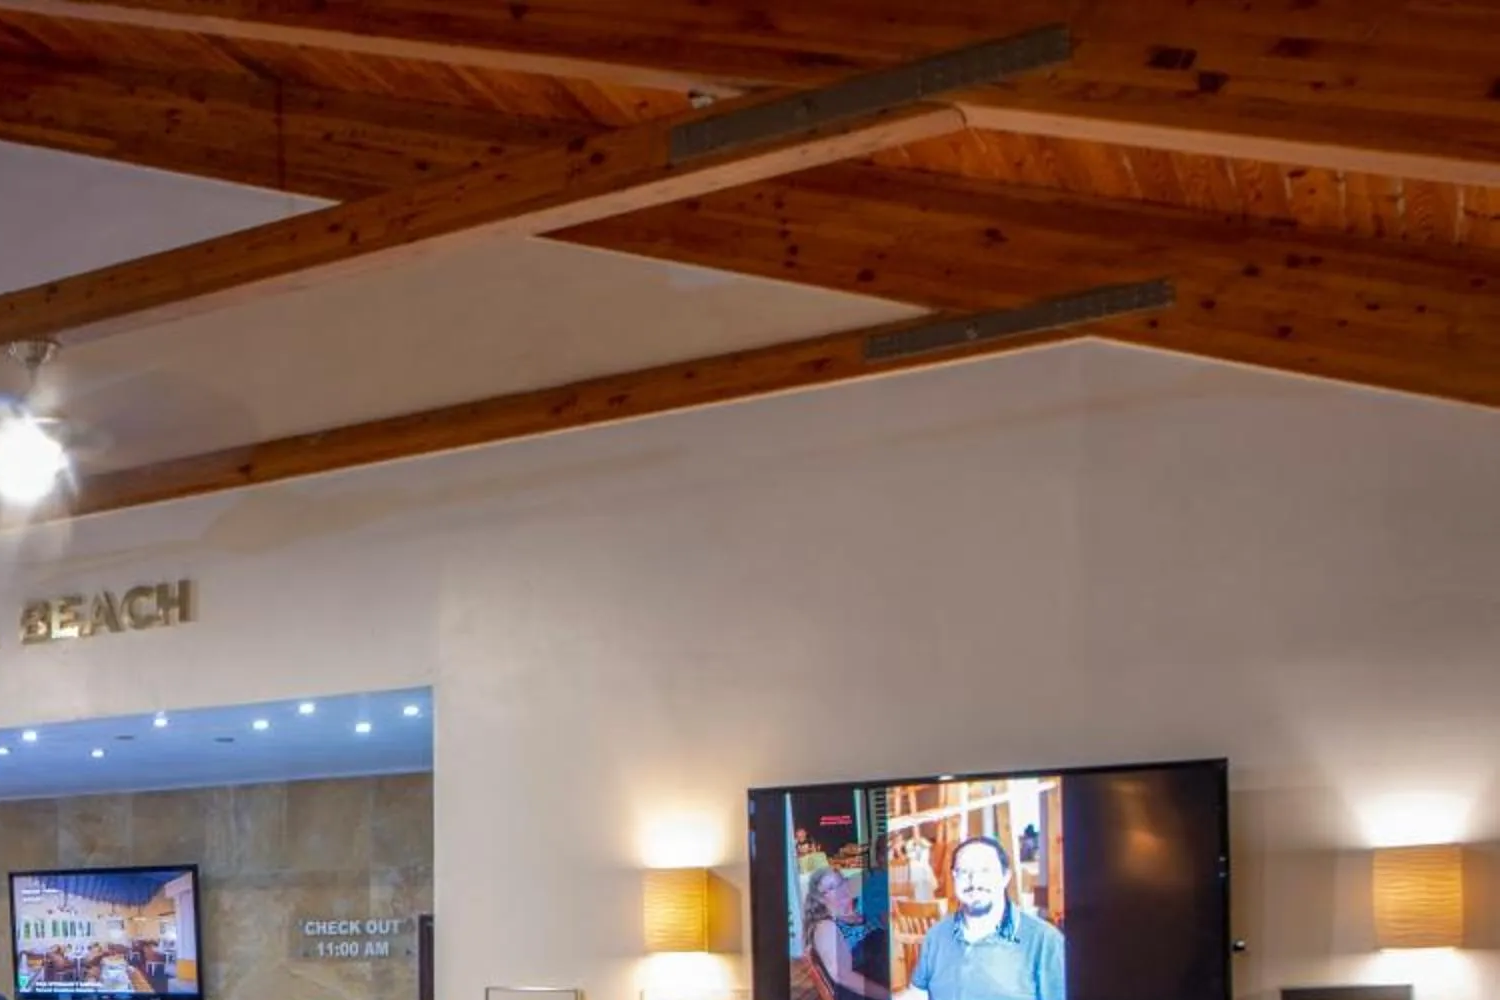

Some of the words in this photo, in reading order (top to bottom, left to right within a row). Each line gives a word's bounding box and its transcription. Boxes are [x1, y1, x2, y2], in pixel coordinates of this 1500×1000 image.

[19, 578, 195, 645] BEACH
[303, 920, 361, 936] CHECK
[364, 918, 399, 934] OUT
[318, 941, 359, 957] 11:00
[364, 941, 389, 956] AM
